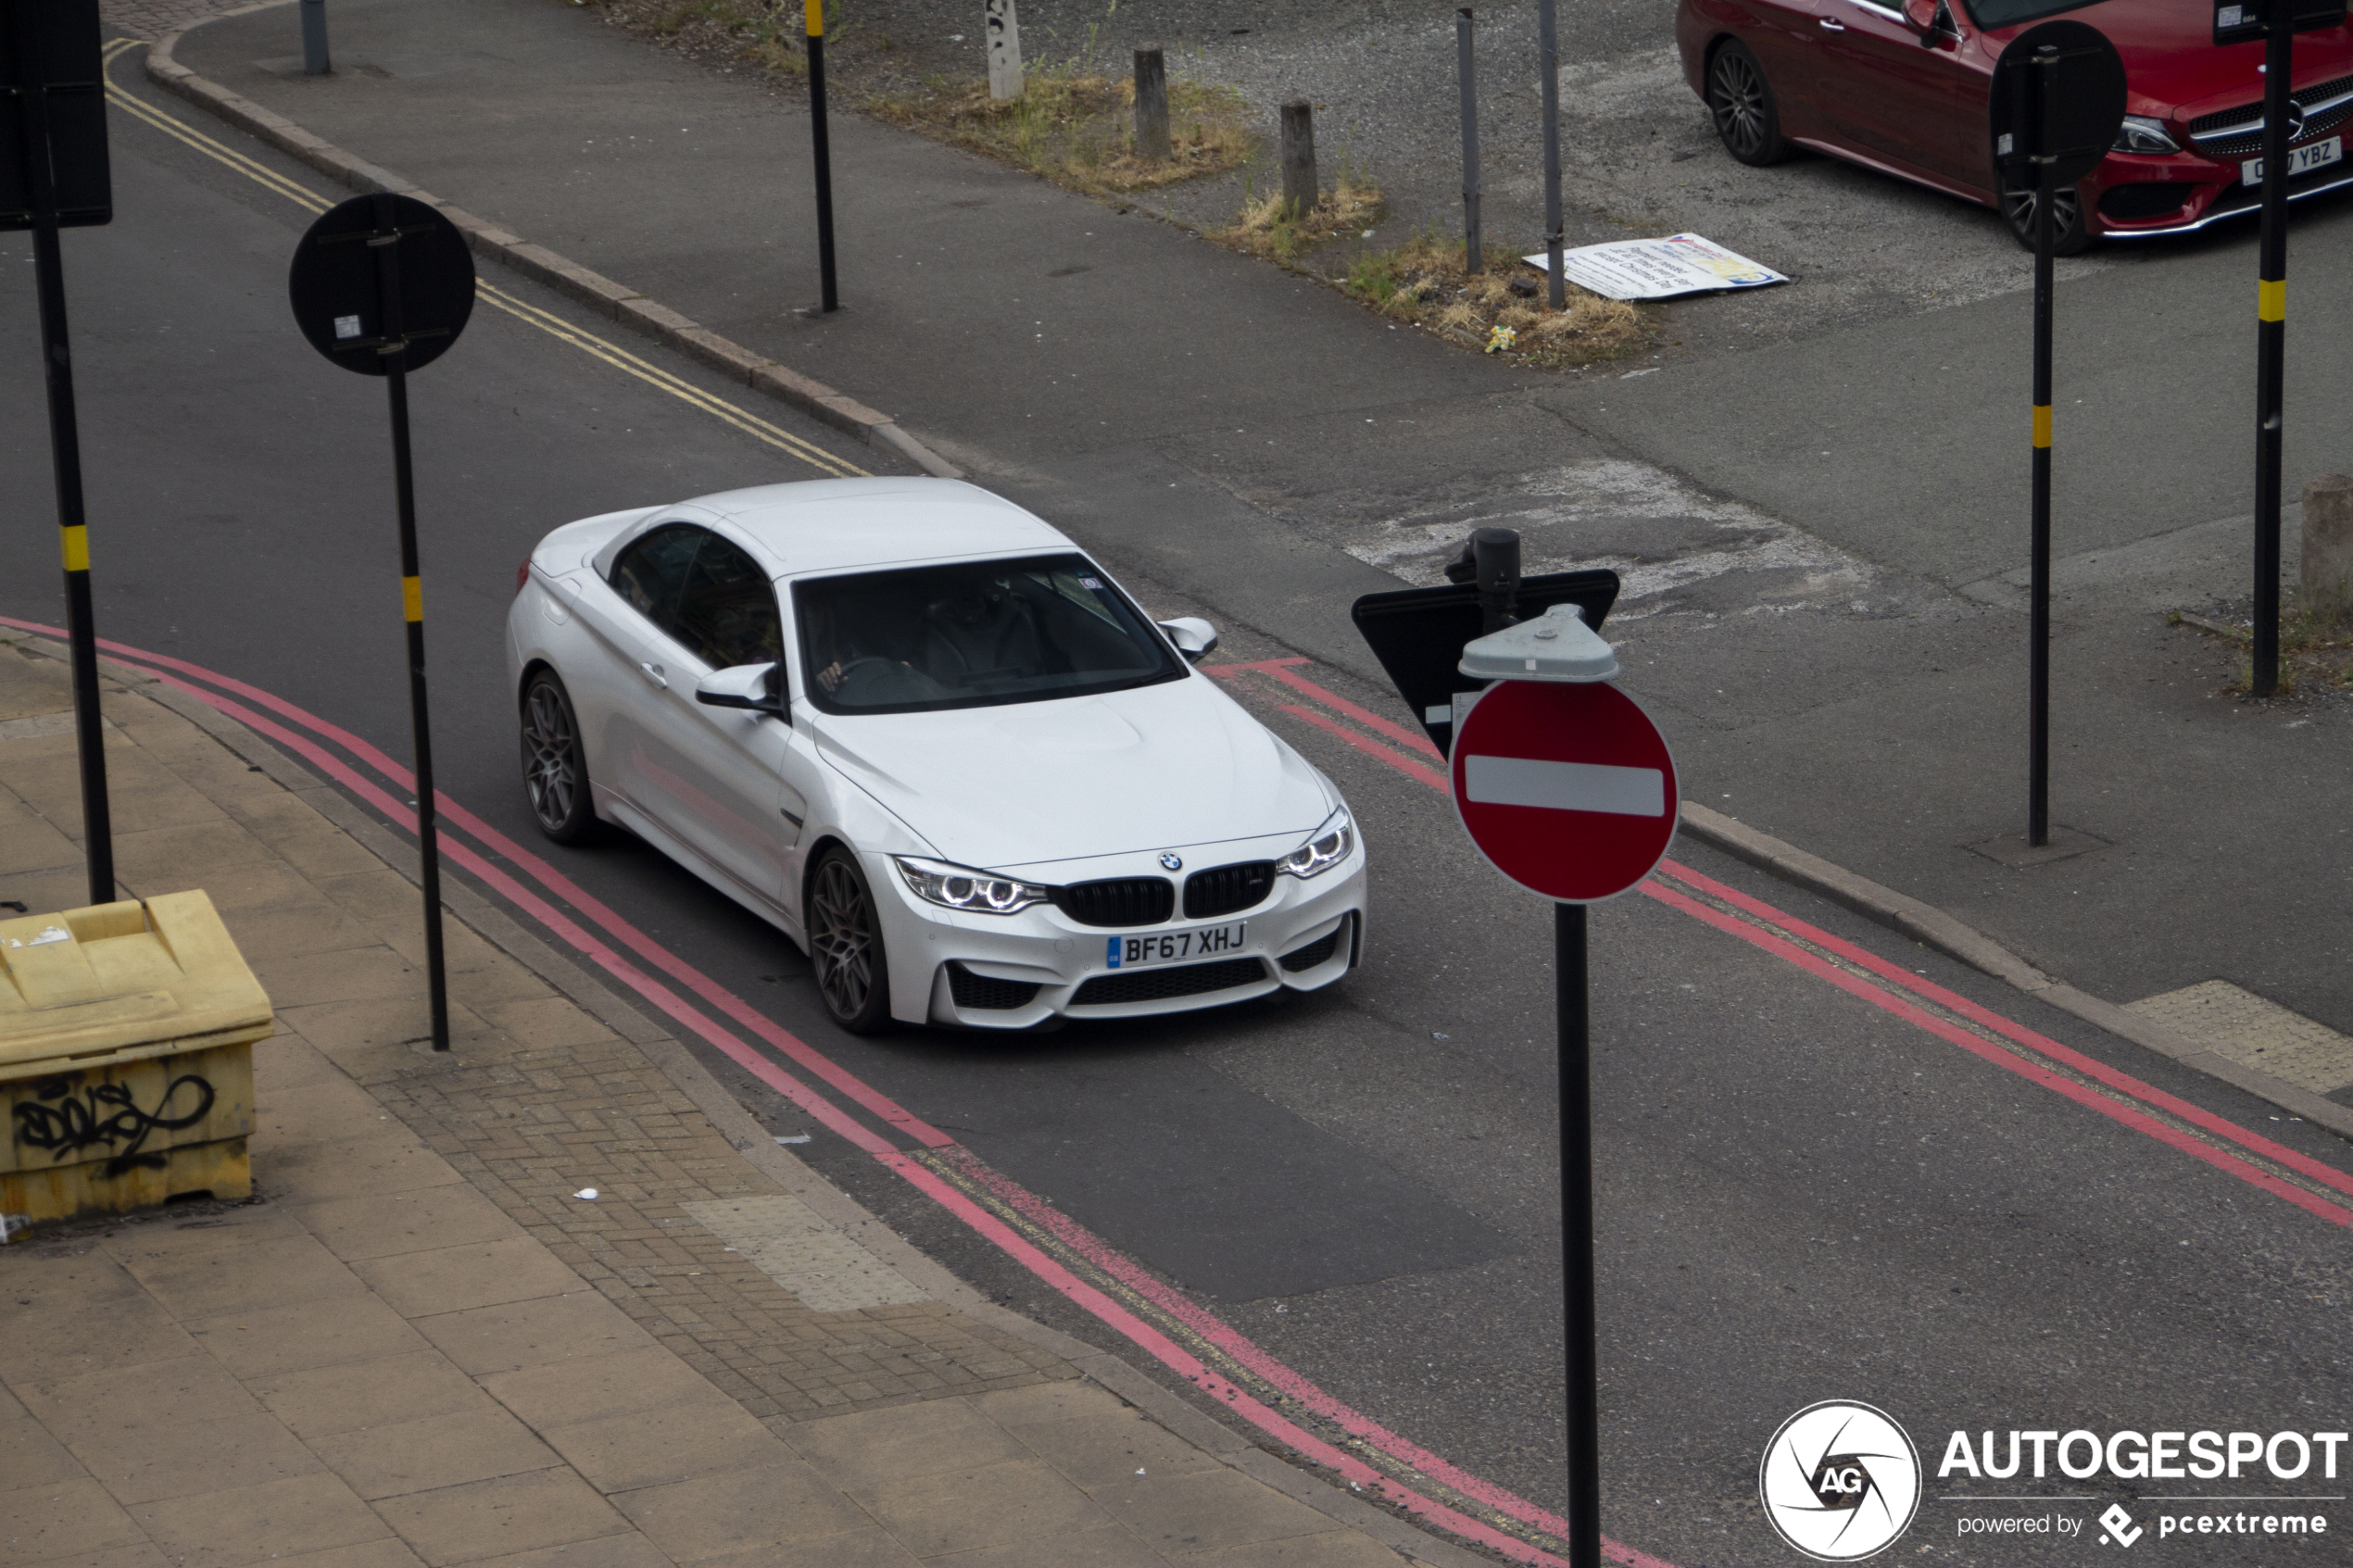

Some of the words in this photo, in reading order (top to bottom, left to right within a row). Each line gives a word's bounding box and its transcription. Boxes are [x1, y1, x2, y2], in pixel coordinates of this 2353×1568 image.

[2300, 142, 2331, 167] YBZ
[1126, 933, 1191, 962] BF67
[1198, 924, 1244, 953] XHJ
